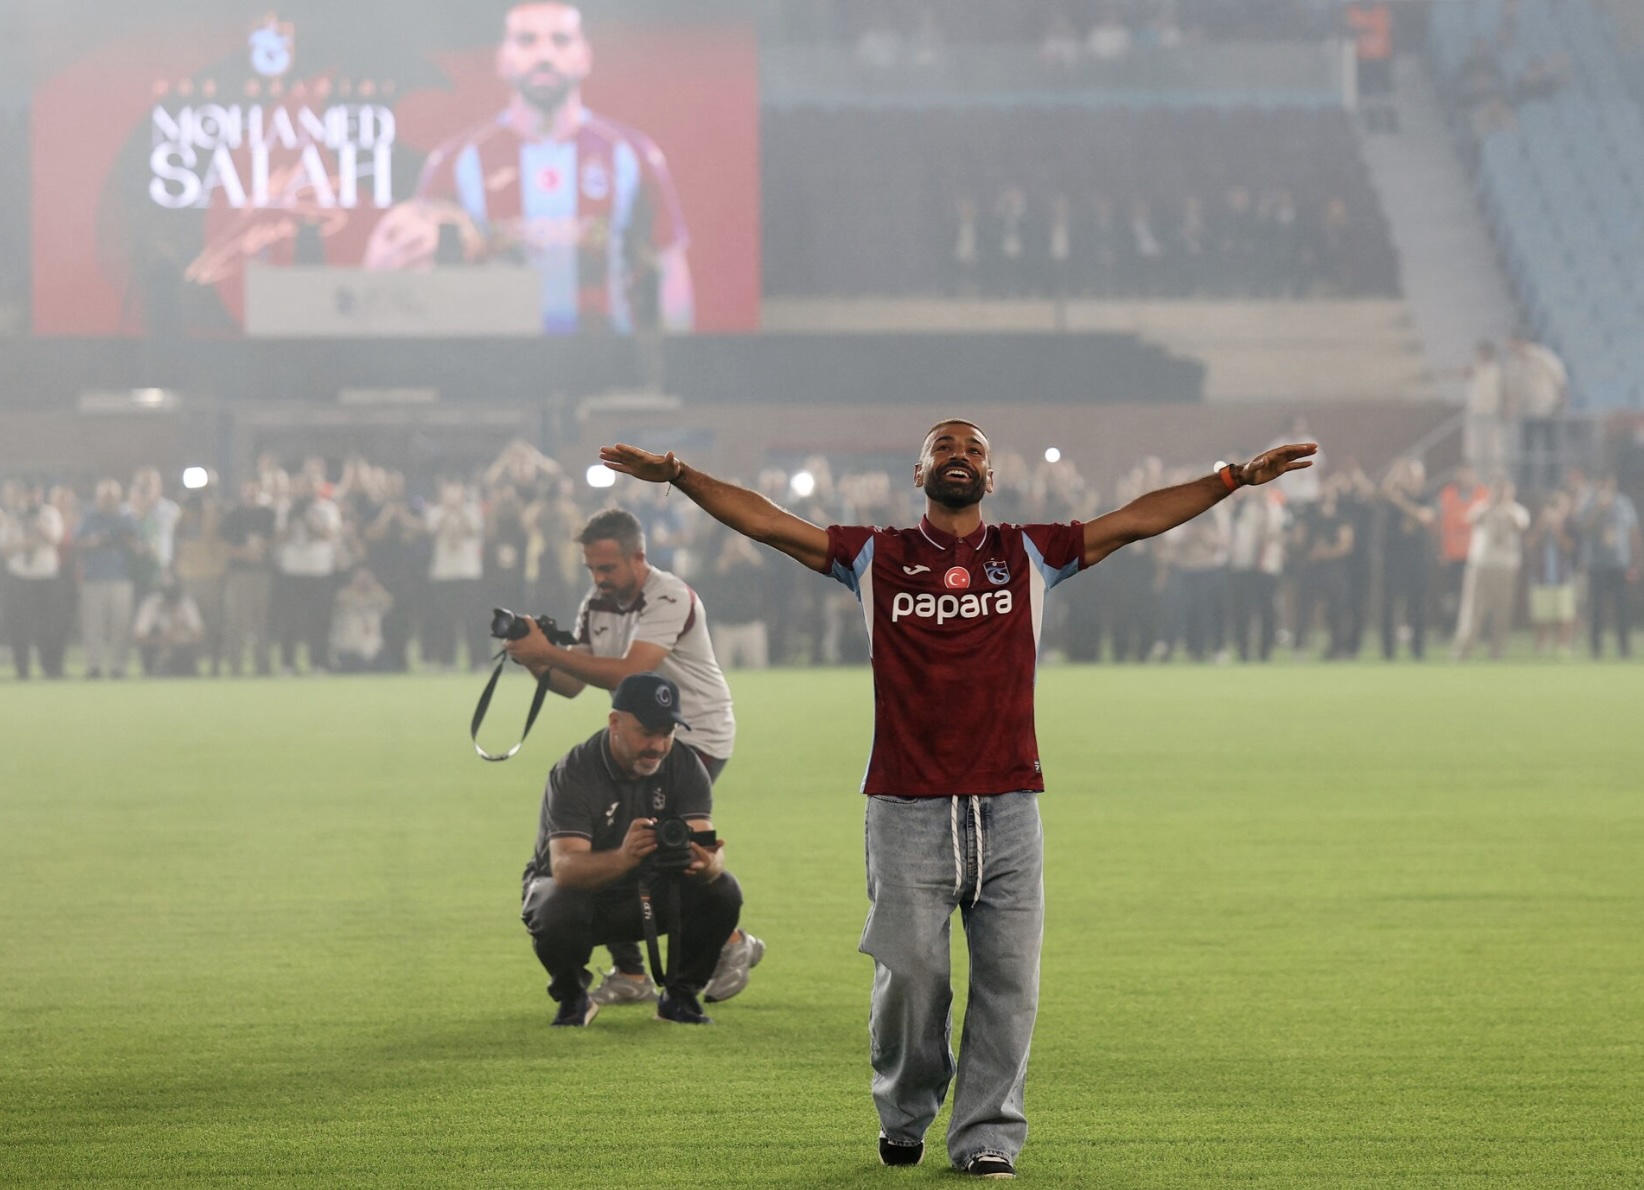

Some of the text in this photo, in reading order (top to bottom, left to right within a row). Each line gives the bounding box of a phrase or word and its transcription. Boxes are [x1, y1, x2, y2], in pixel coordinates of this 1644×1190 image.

[152, 103, 396, 149] MOHAMED
[149, 141, 393, 209] SALAH
[892, 589, 1012, 625] papara
